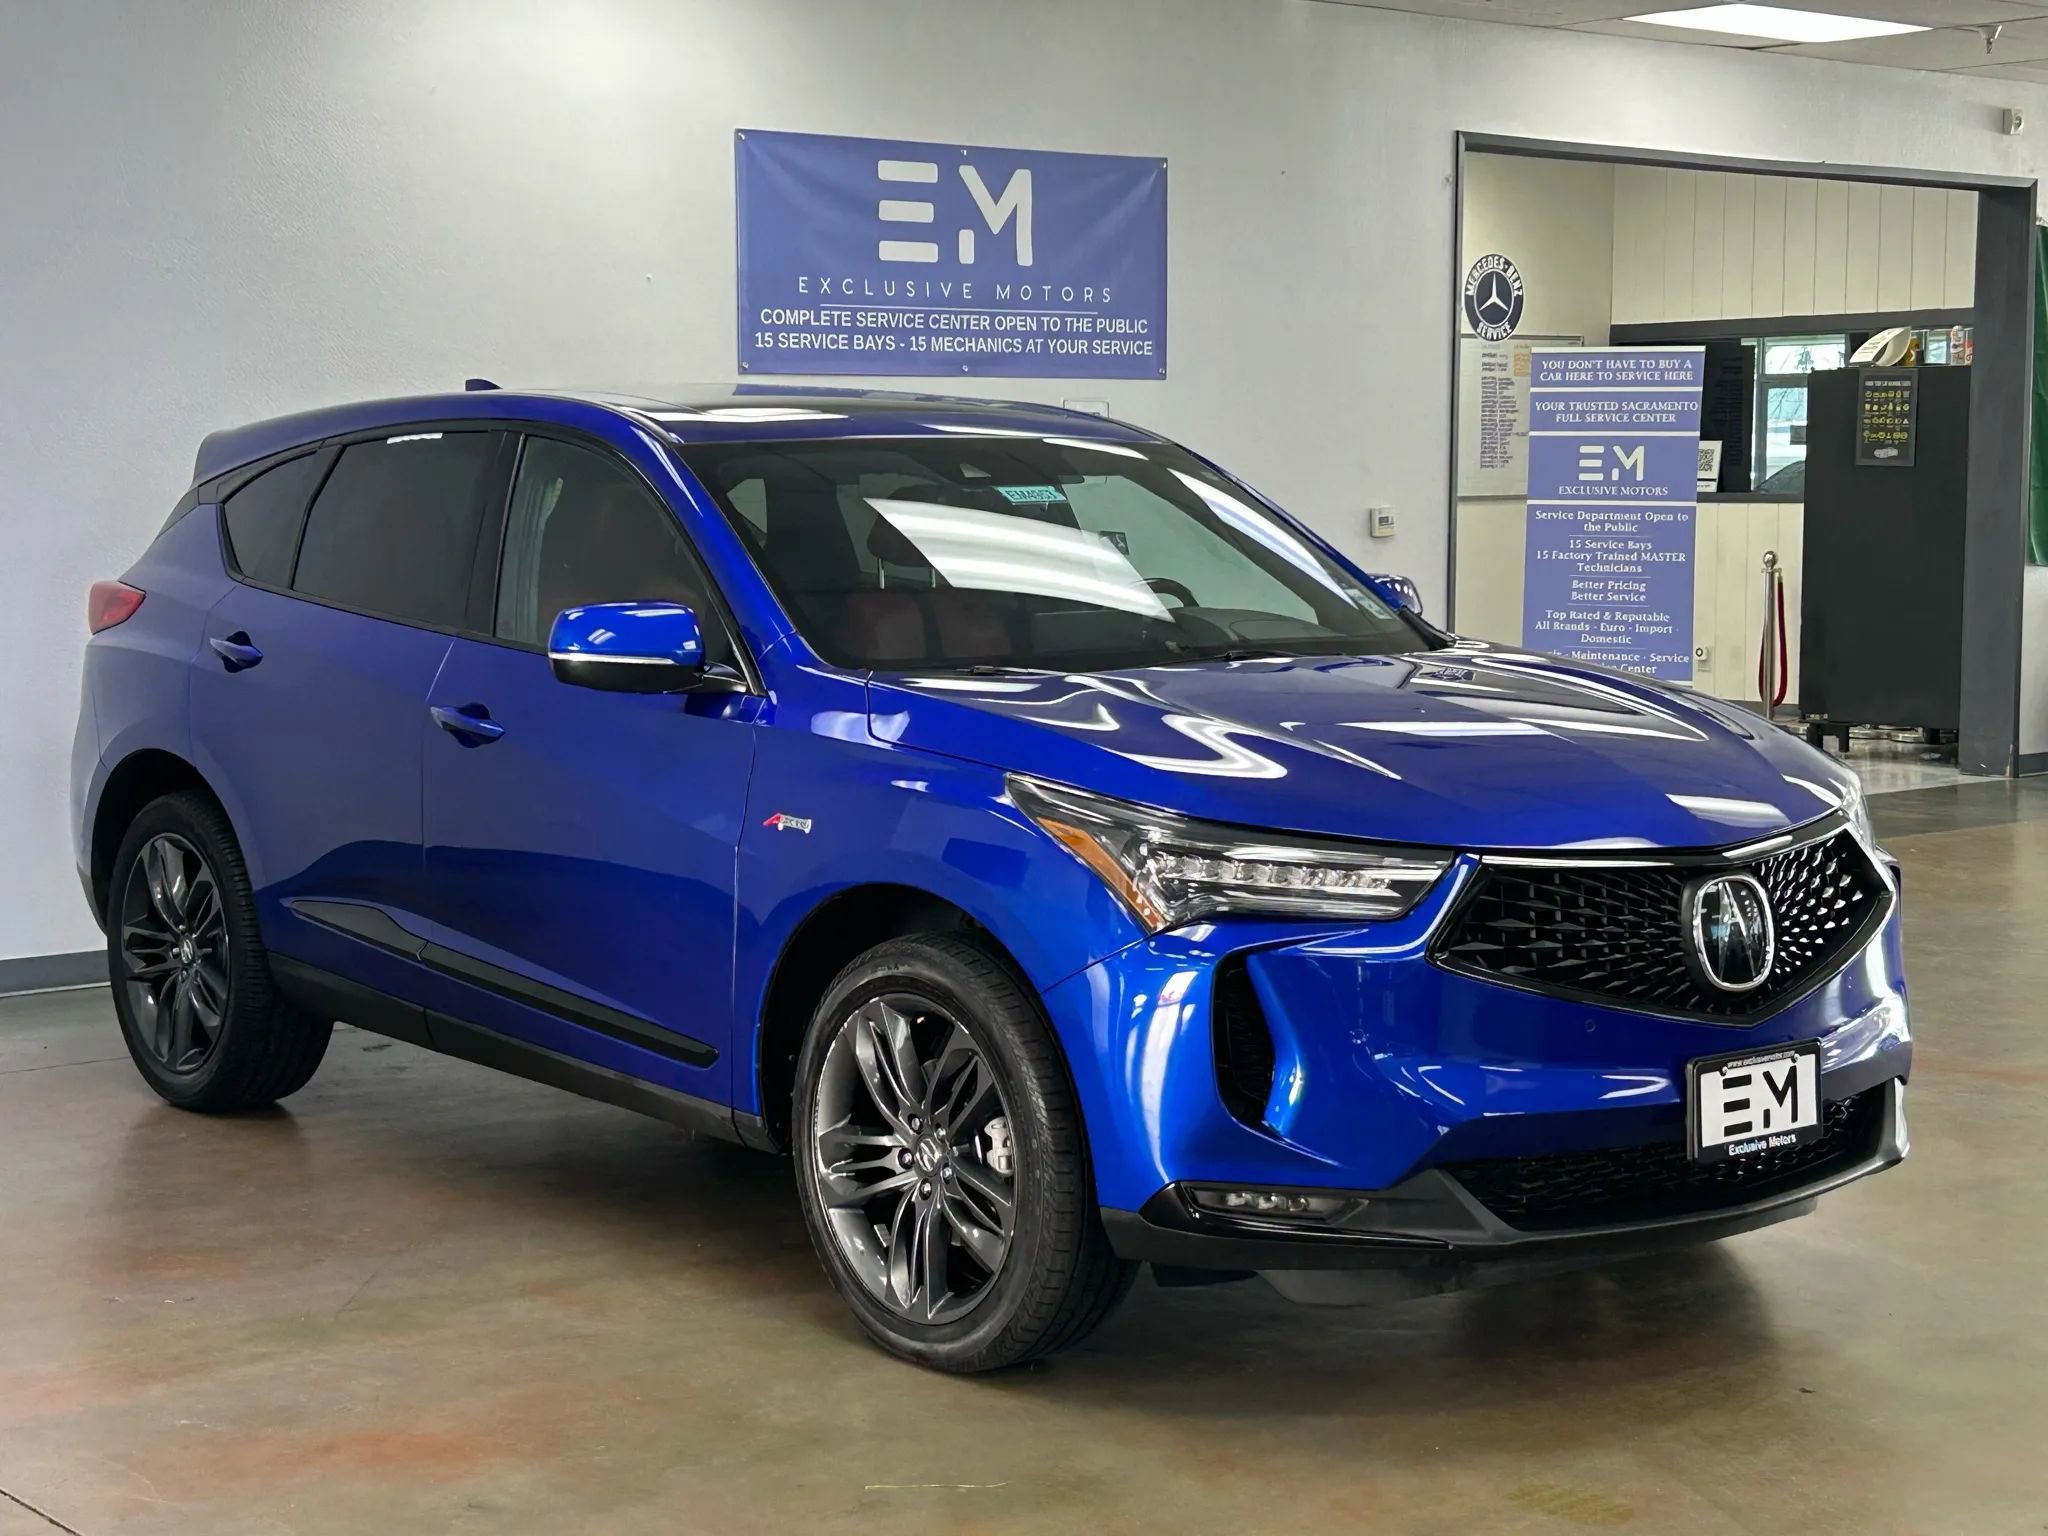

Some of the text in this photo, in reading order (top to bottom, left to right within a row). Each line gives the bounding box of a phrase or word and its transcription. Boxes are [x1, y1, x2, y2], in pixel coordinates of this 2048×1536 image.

[878, 160, 1032, 266] EM
[799, 276, 1111, 304] EXCLUSIVE MOTORS
[760, 308, 1149, 334] COMPLETE SERVICE CENTER OPEN TO THE PUBLIC
[1476, 321, 1512, 340] SERVICE
[754, 331, 774, 349] 15
[777, 333, 849, 351] SERVICE
[852, 334, 896, 352] BAYS
[909, 336, 927, 352] 15
[930, 336, 1023, 354] MECHANICS
[1026, 338, 1044, 354] AT
[1047, 339, 1088, 355] YOUR
[1091, 340, 1153, 356] SERVICE
[1542, 359, 1692, 370] YOU DON'T HAVE TO BUY A
[1540, 371, 1694, 381] CAR HERE TO SERVICE HERE
[1536, 401, 1698, 411] YOUR TRUSTED SACRAMENTO
[1556, 413, 1676, 423] FULL SERVICE CENTER
[1579, 446, 1644, 481] EM
[1559, 486, 1668, 496] EXCLUSIVE MOTORS
[1535, 511, 1688, 522] Service Department Open to
[1584, 523, 1638, 532] the Public
[1569, 540, 1652, 550] 15 Service Bays
[1537, 551, 1686, 562] 15 Factory Trained MASTER
[1577, 563, 1643, 573] Technicians
[1572, 580, 1646, 591] Better Pricing
[1572, 592, 1646, 602] Better Service
[1546, 610, 1670, 622] Top Rated & Reputable
[1536, 621, 1550, 630] All
[1553, 622, 1590, 631] Brands
[1600, 623, 1625, 632] Euro
[1635, 624, 1673, 634] Import
[1581, 634, 1633, 644] Domestic
[1572, 651, 1640, 662] Maintenance
[1650, 653, 1689, 663] Service
[1723, 1065, 1798, 1137] EM
[1728, 1134, 1796, 1156] Exclusive Motors
